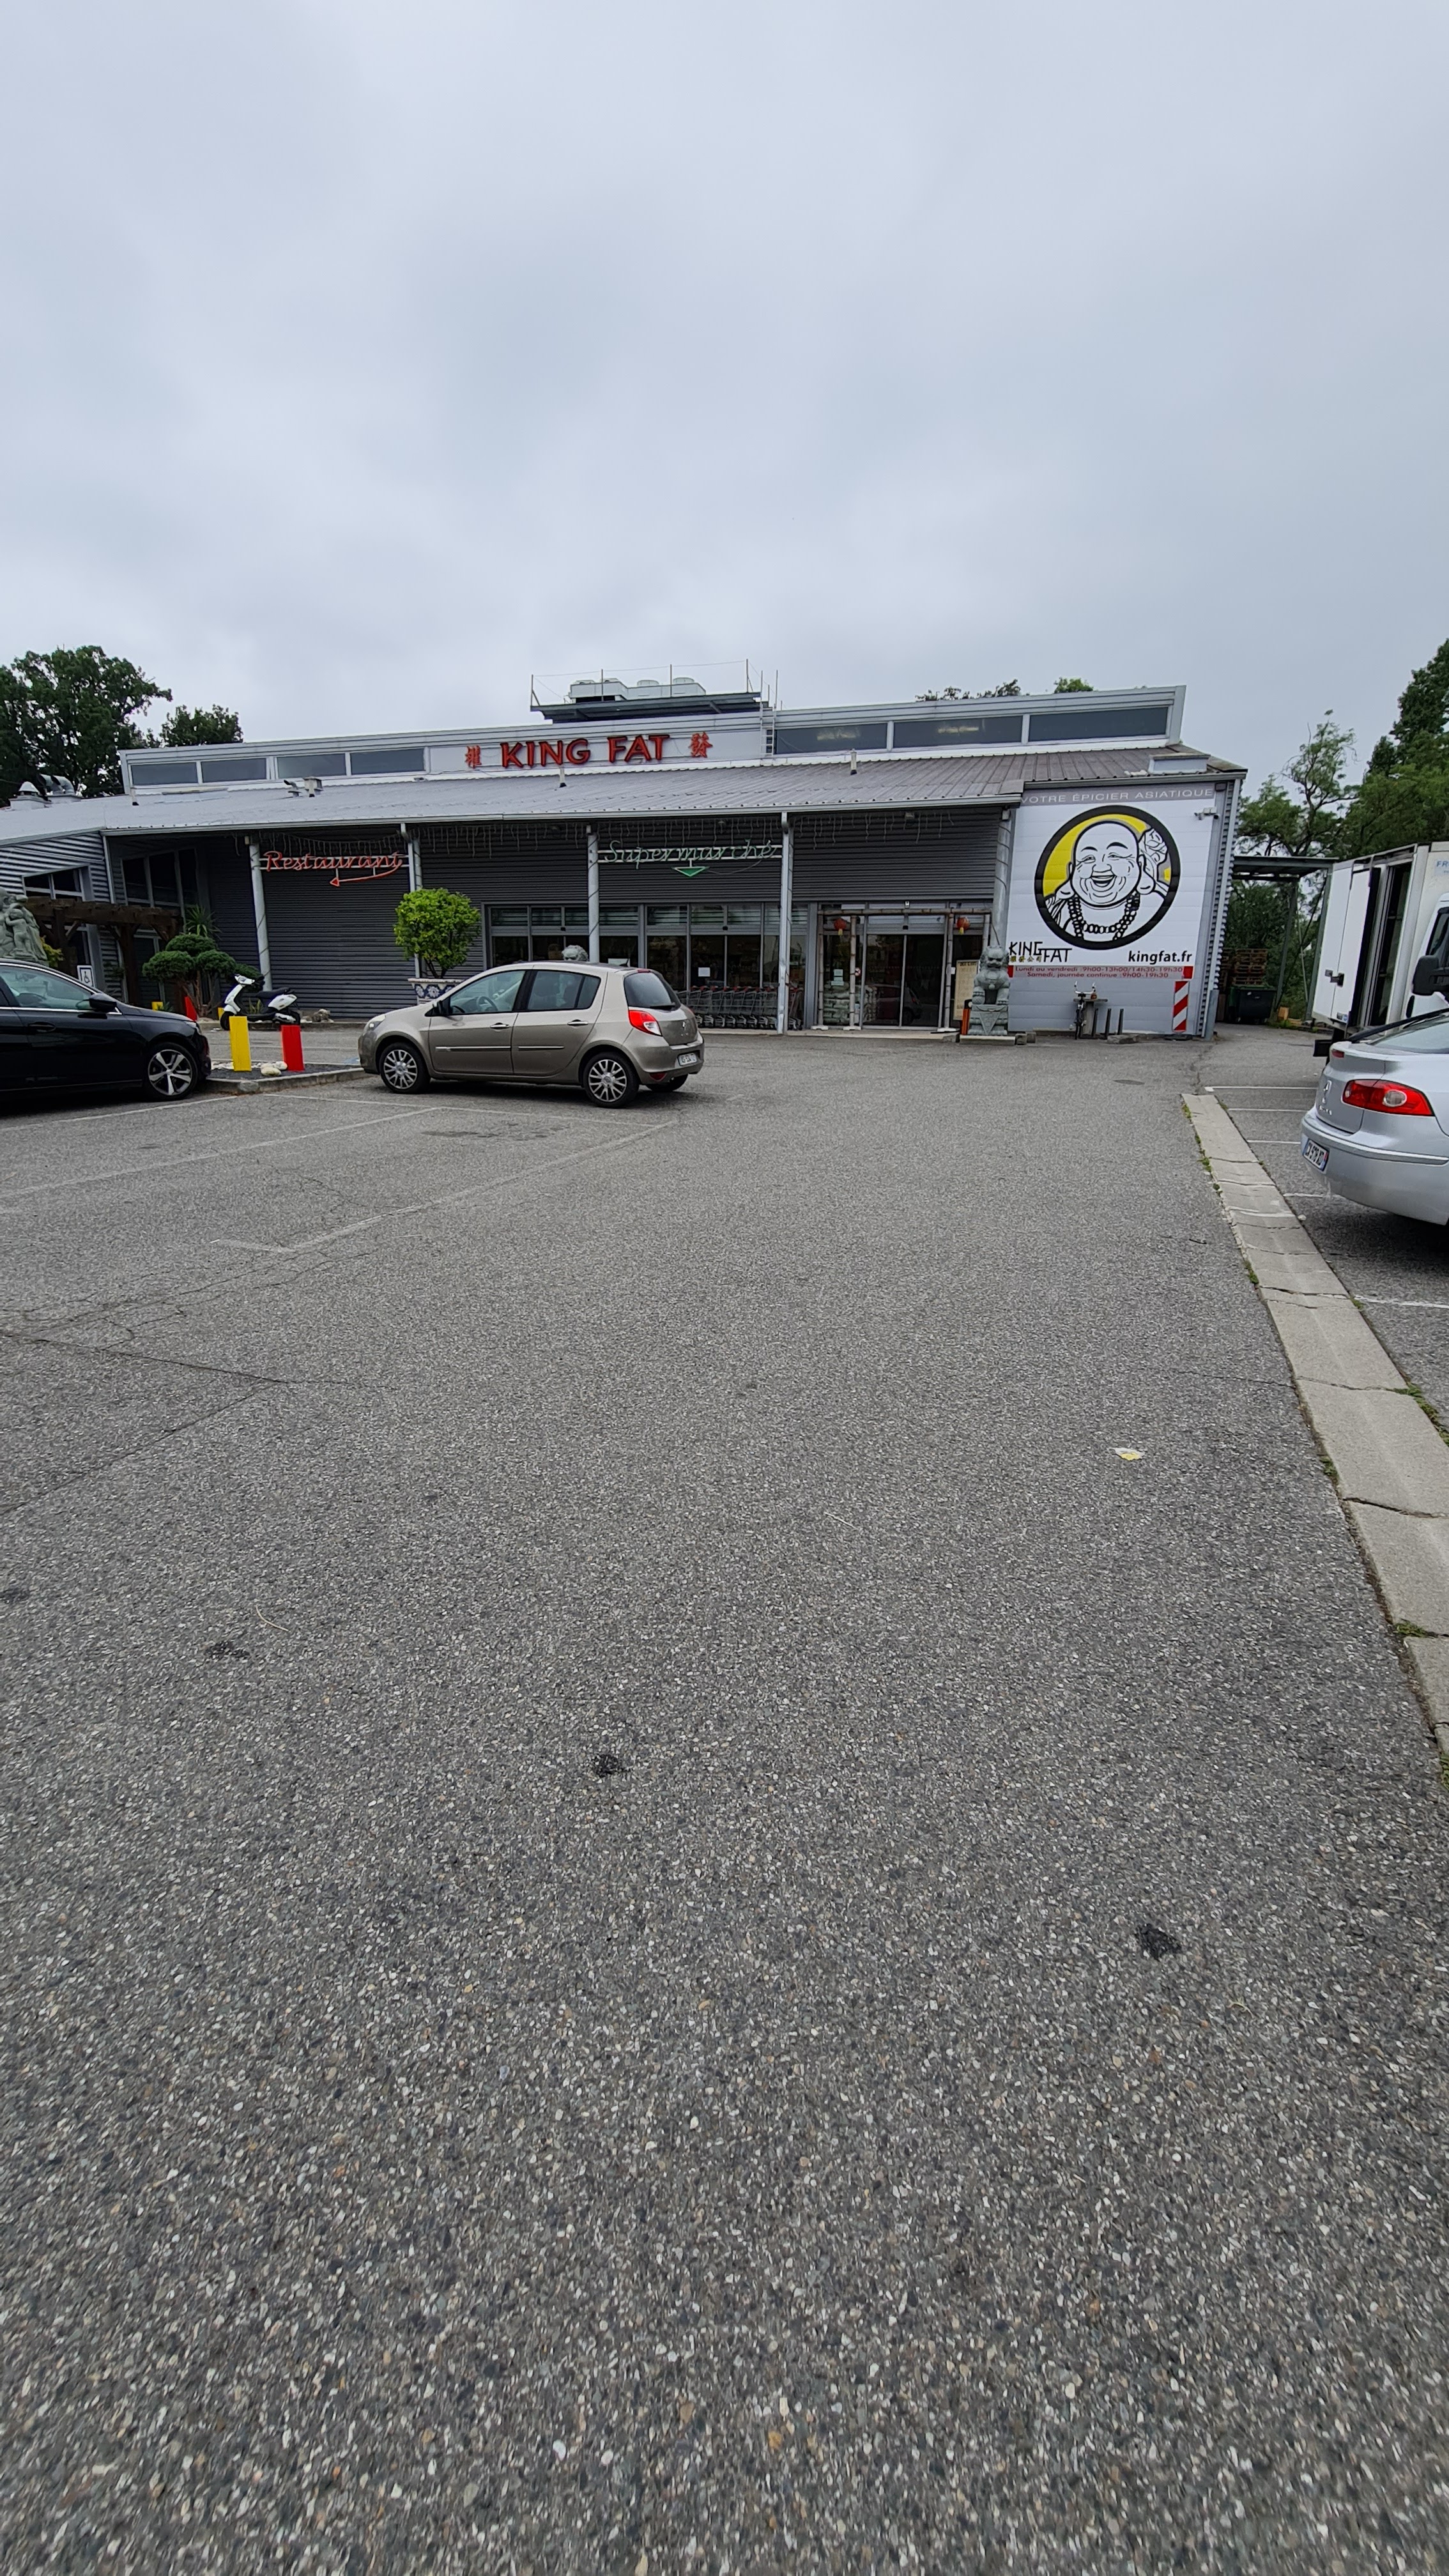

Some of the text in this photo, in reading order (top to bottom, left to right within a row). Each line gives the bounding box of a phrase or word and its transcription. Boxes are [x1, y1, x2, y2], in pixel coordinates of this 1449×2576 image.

[500, 734, 670, 768] KING FAT
[1020, 788, 1213, 804] VOTRE ÉPICIER ASIATIQUE
[263, 850, 406, 872] Restaurant
[604, 839, 778, 870] Supermarché
[1009, 941, 1043, 956] KING
[1038, 948, 1072, 963] FAT
[1128, 950, 1193, 965] kingfat.fr
